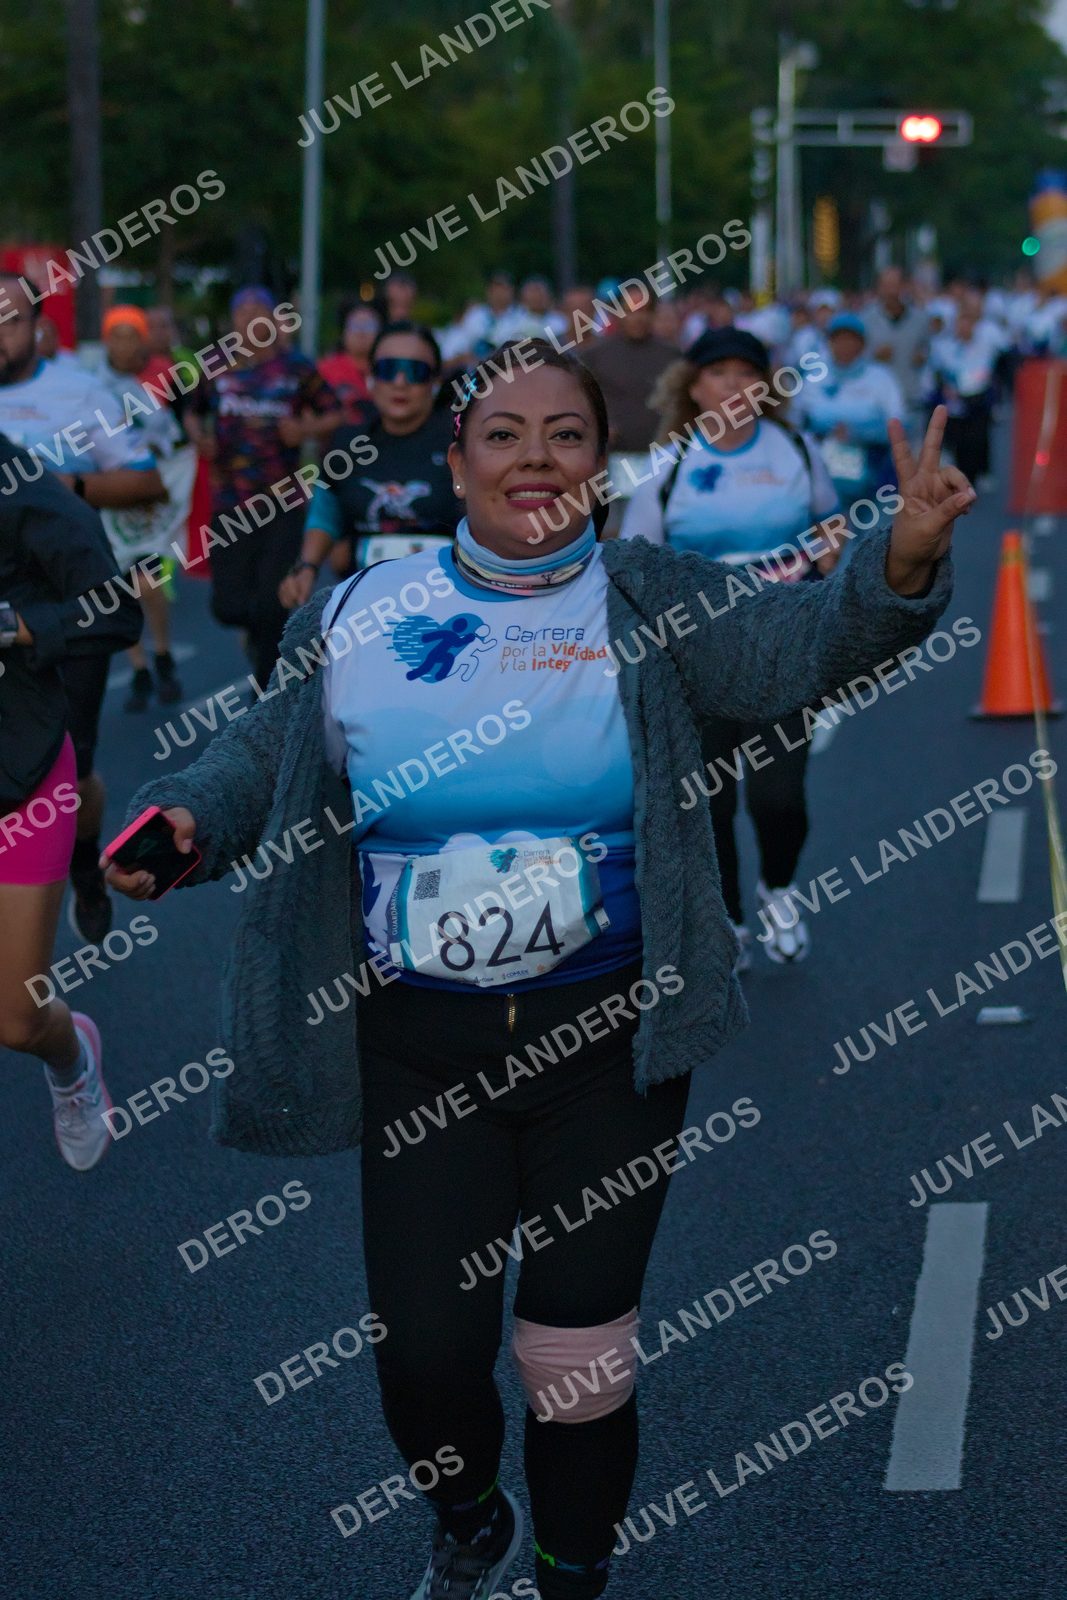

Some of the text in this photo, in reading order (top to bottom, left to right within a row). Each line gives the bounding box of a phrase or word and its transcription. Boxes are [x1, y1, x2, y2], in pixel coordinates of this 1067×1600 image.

[505, 625, 585, 642] Carrera
[502, 646, 529, 661] por
[532, 642, 546, 657] la
[501, 660, 508, 674] y
[512, 658, 526, 671] la
[437, 900, 565, 972] 824
